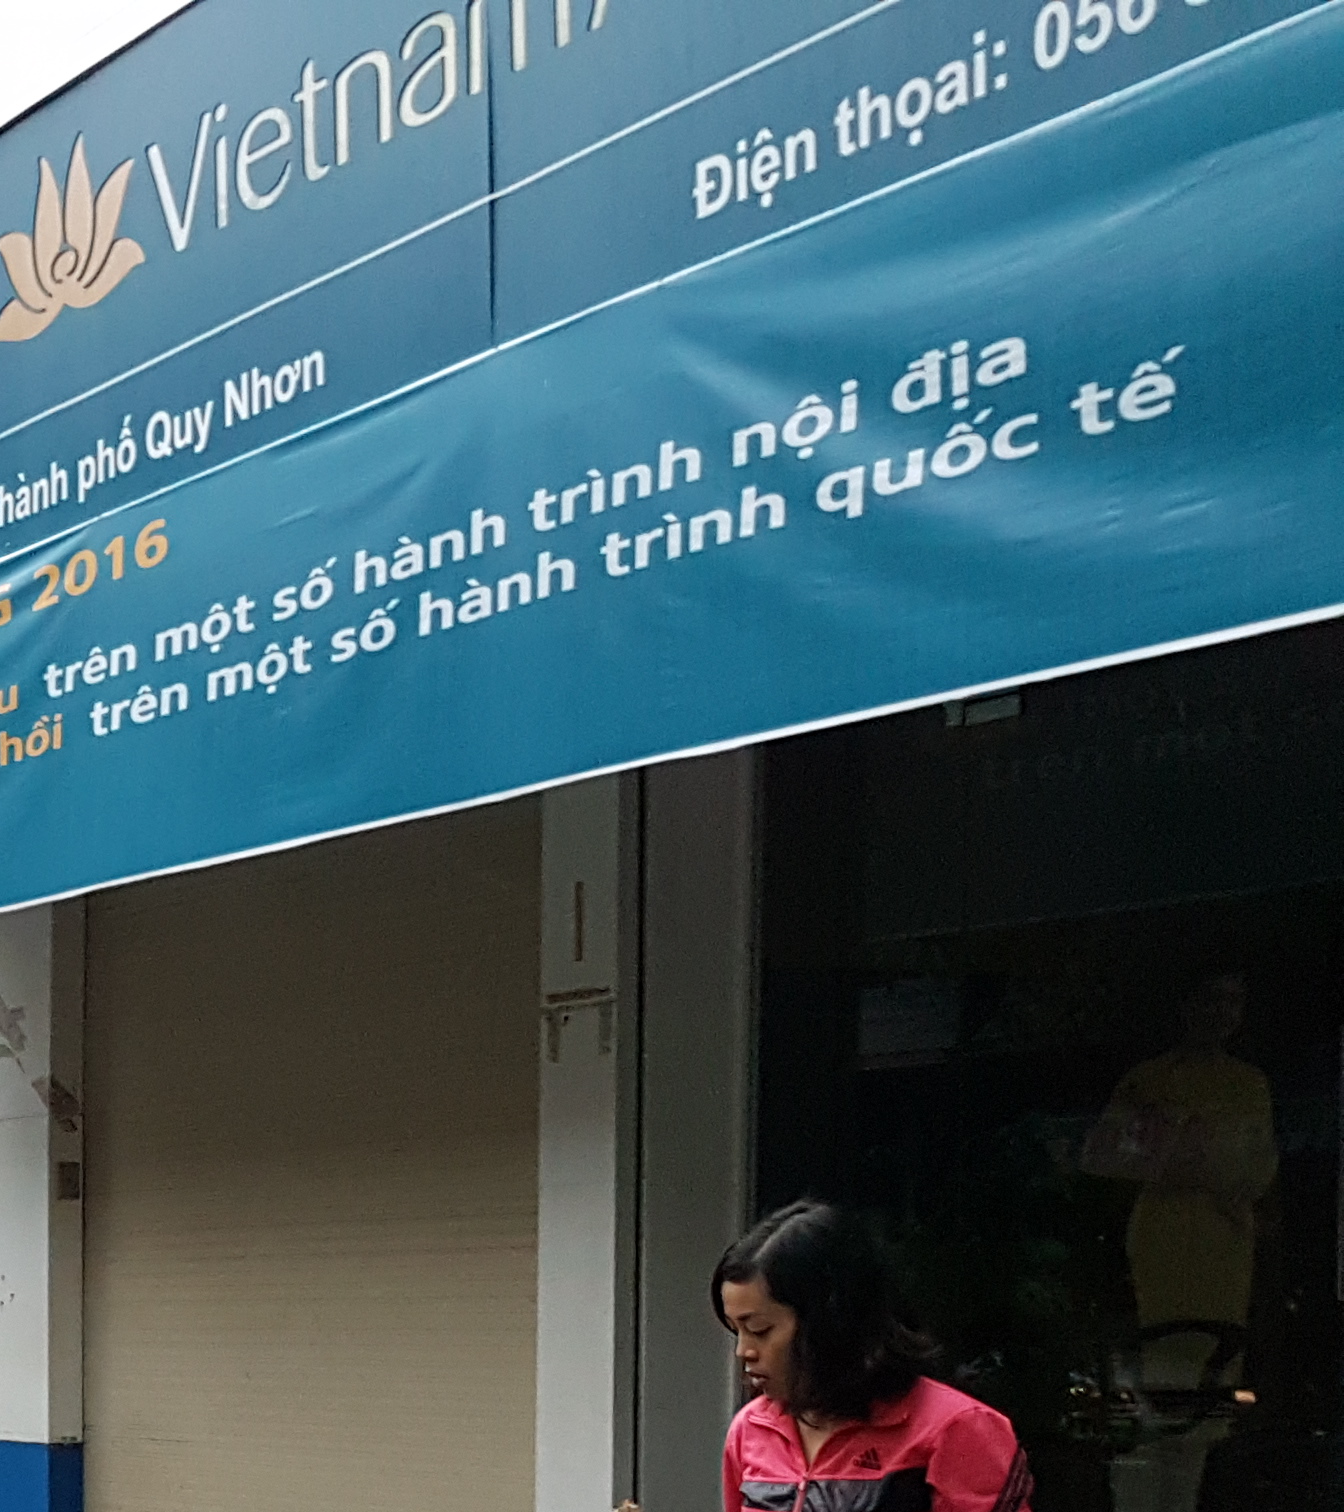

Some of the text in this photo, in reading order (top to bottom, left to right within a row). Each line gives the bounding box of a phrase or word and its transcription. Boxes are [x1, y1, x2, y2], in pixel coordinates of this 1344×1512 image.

[693, 129, 817, 219] Điện
[78, 415, 137, 502] phố
[145, 401, 214, 460] Quy
[224, 350, 326, 428] Nhơn
[31, 518, 170, 612] 2016
[44, 641, 137, 698] trên
[154, 595, 256, 662] một
[271, 556, 337, 623] số
[353, 508, 506, 595] hành
[528, 440, 702, 533] trình
[732, 378, 859, 468] nội
[892, 336, 1028, 415] địa
[90, 680, 190, 737] trên
[206, 636, 315, 702] một
[329, 598, 401, 664] số
[418, 551, 577, 636] hành
[600, 485, 787, 577] trình
[815, 407, 1039, 519] quốc
[1071, 344, 1187, 436] tế
